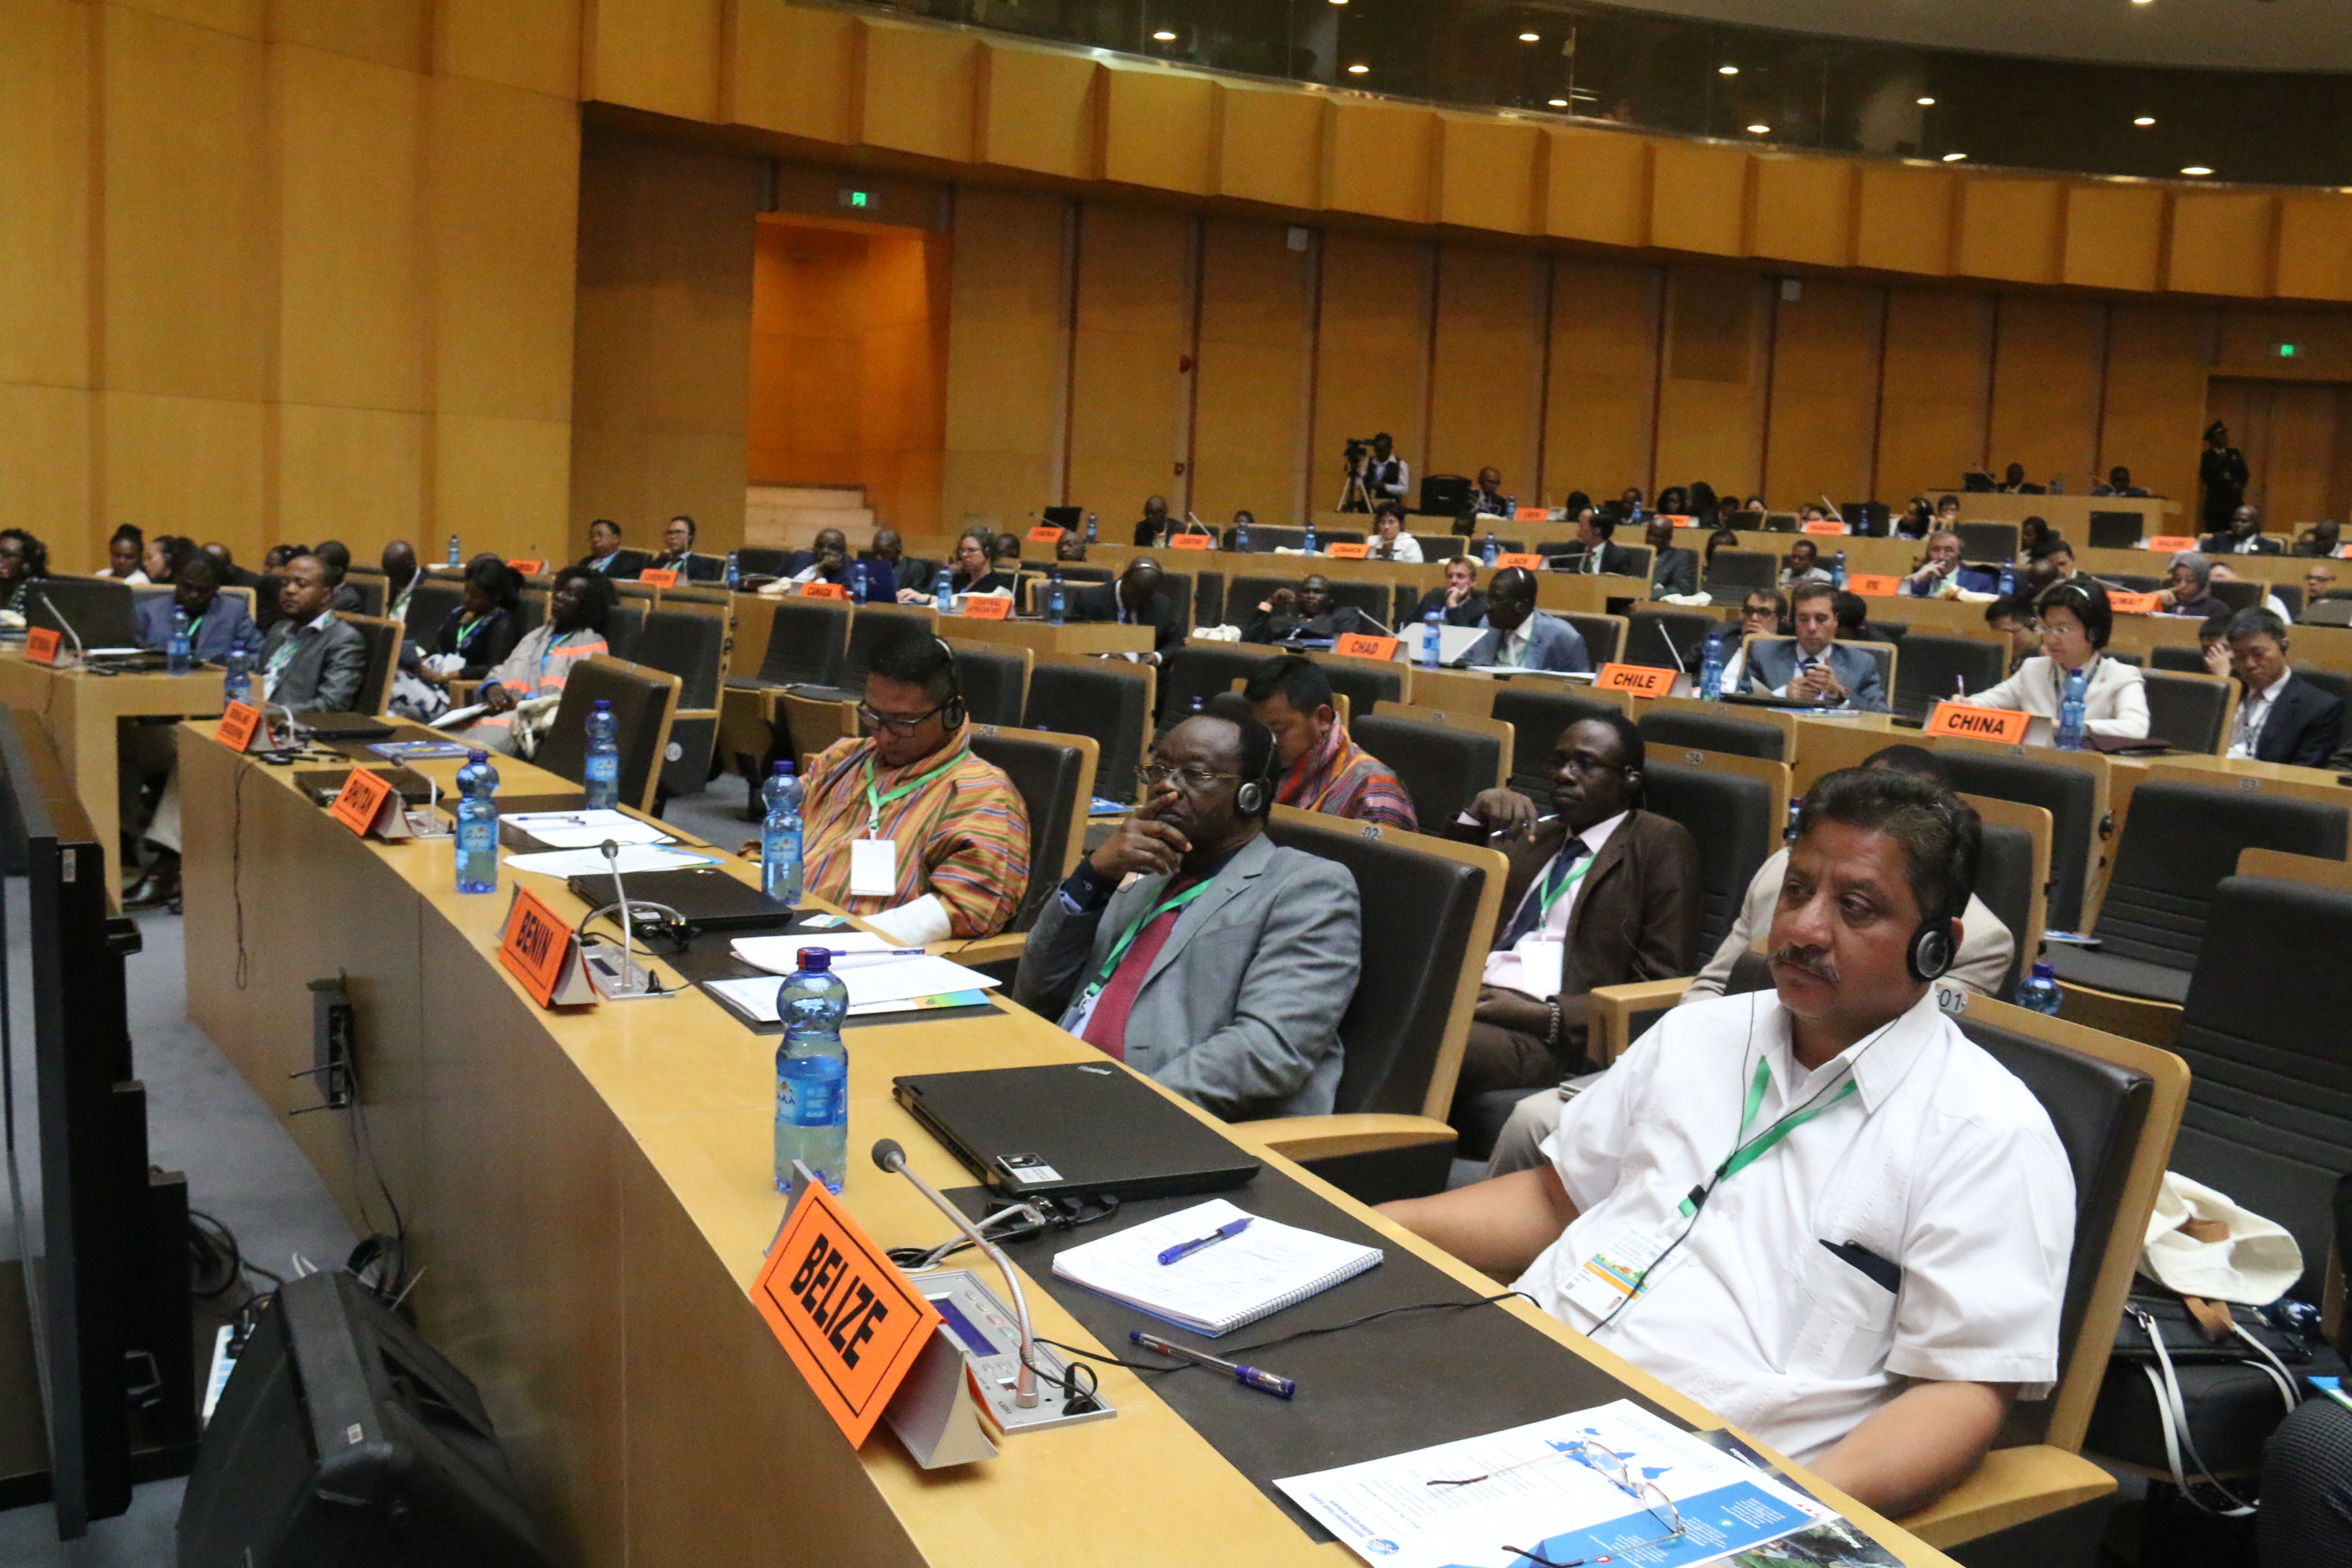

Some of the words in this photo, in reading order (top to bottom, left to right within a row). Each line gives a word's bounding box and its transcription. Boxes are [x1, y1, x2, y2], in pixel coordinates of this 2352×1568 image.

[1351, 640, 1378, 654] CHAD
[1613, 673, 1656, 689] CHILE
[1948, 714, 2004, 735] CHINA
[516, 908, 554, 970] BENIN
[1939, 989, 1961, 1011] 01
[790, 1233, 888, 1371] BELIZE
